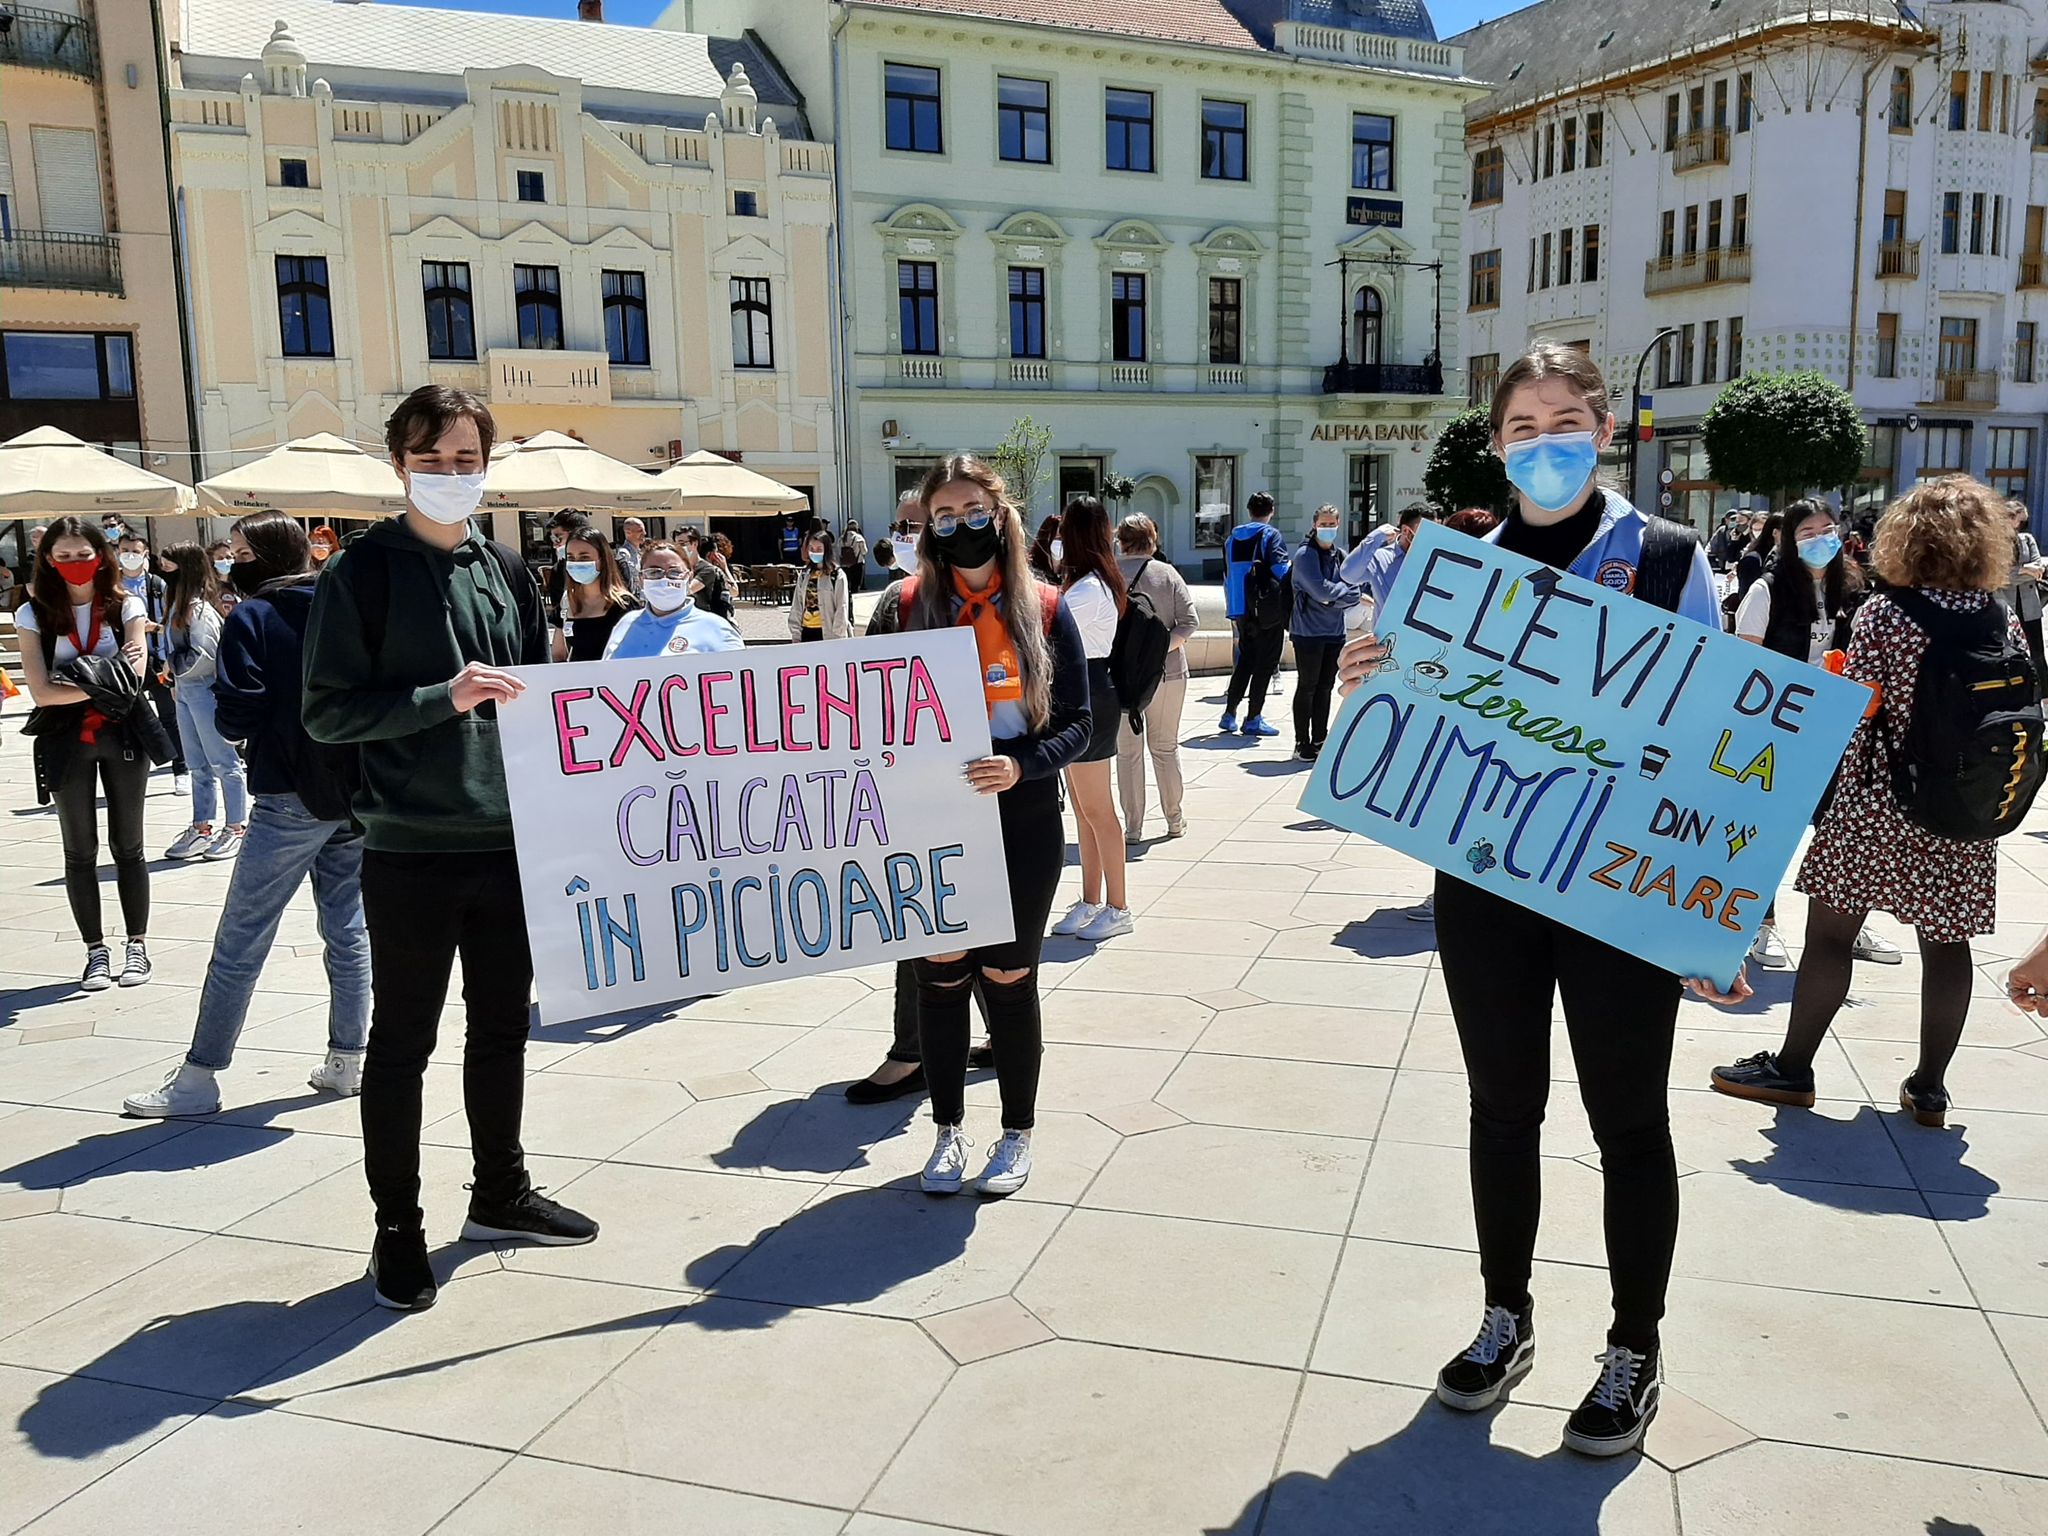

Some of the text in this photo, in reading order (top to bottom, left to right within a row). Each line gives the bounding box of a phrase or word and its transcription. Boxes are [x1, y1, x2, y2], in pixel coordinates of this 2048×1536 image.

[1311, 424, 1429, 441] ALPHA BANK
[551, 655, 952, 775] EXCELENȚA
[1439, 669, 1626, 769] terase
[1733, 668, 1815, 734] DE
[1708, 729, 1776, 792] LA
[617, 758, 890, 867] CĂLCATĂ
[1648, 797, 1716, 846] DIN
[1588, 841, 1760, 932] ZIARE
[565, 875, 647, 990] ÎN
